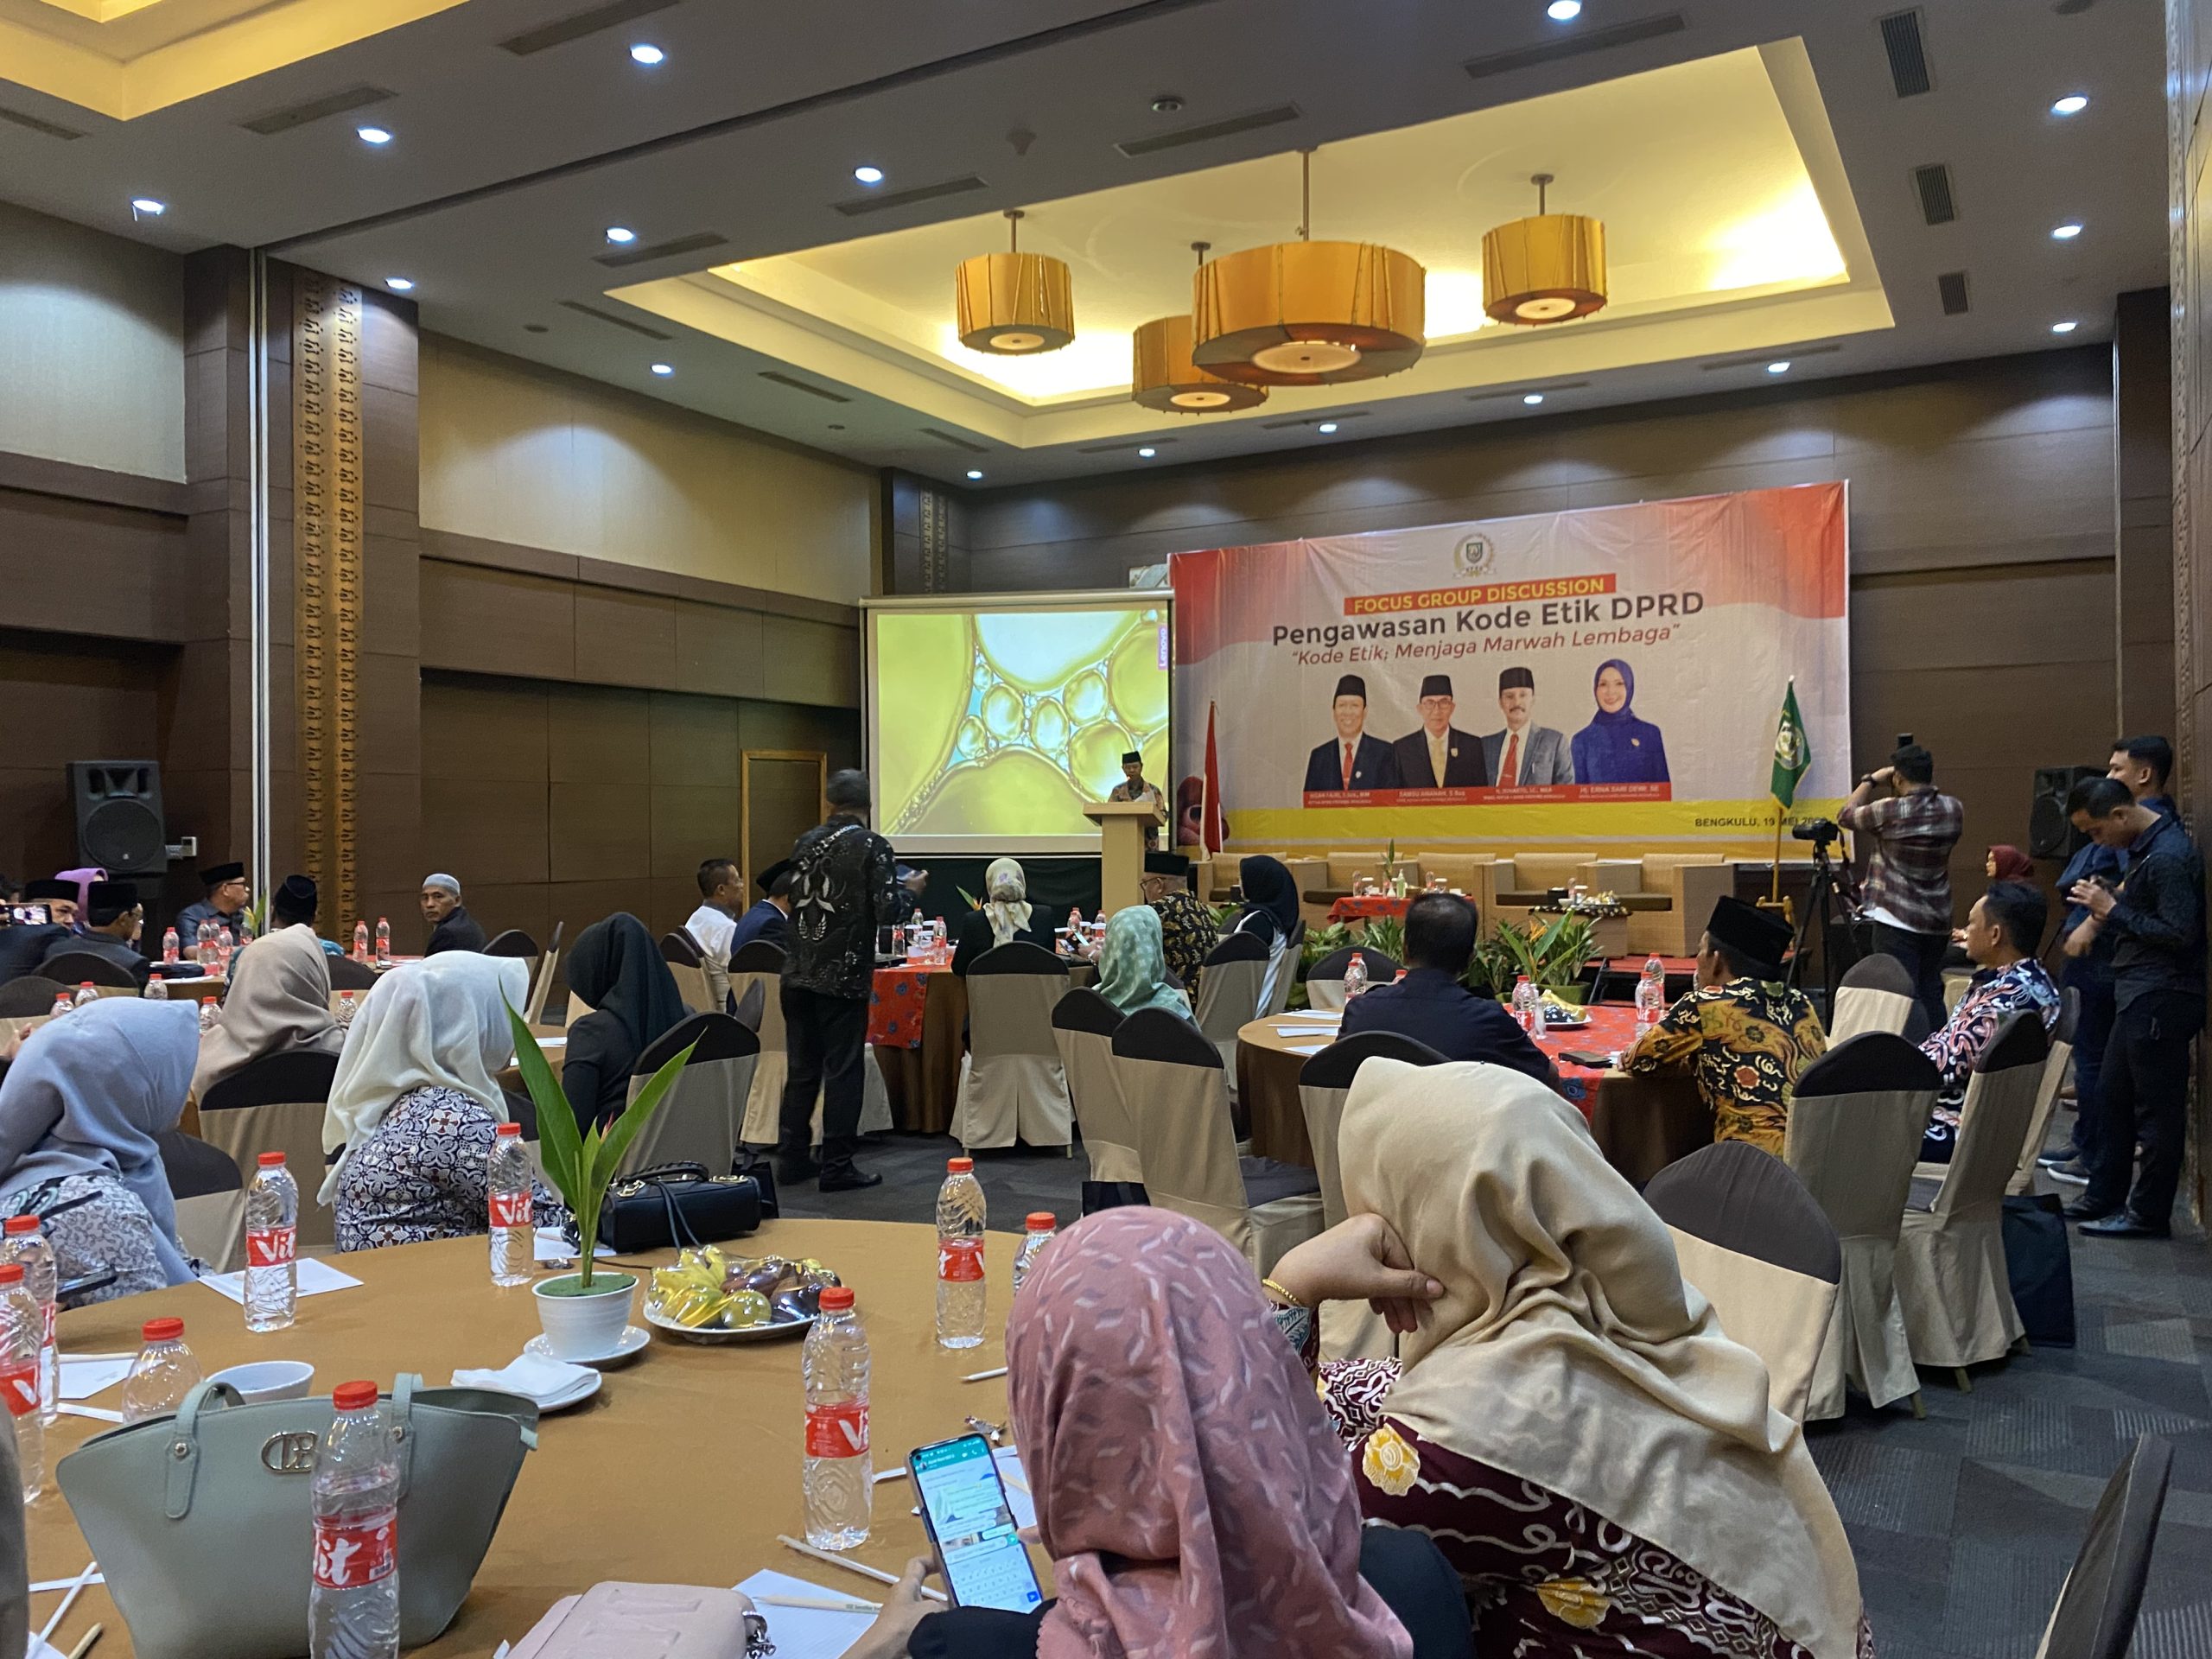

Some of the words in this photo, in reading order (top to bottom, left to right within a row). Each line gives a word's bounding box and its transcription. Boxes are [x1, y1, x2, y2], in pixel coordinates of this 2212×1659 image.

[1354, 595, 1413, 613] FOCUS
[1417, 588, 1482, 607] GROUP
[1487, 578, 1605, 602] DISCUSSION
[1273, 616, 1446, 647] Pengawasan
[1457, 605, 1531, 632] Kode
[1542, 599, 1599, 626] Etik
[1611, 592, 1704, 620] DPRD
[1349, 645, 1389, 663] Etik;
[1395, 639, 1477, 660] Menjaga
[1484, 631, 1565, 652] Marwah
[1695, 817, 1760, 827] BENGKULU,
[1764, 817, 1775, 826] 19
[497, 1198, 532, 1224] Vit
[256, 1232, 295, 1262] Vit
